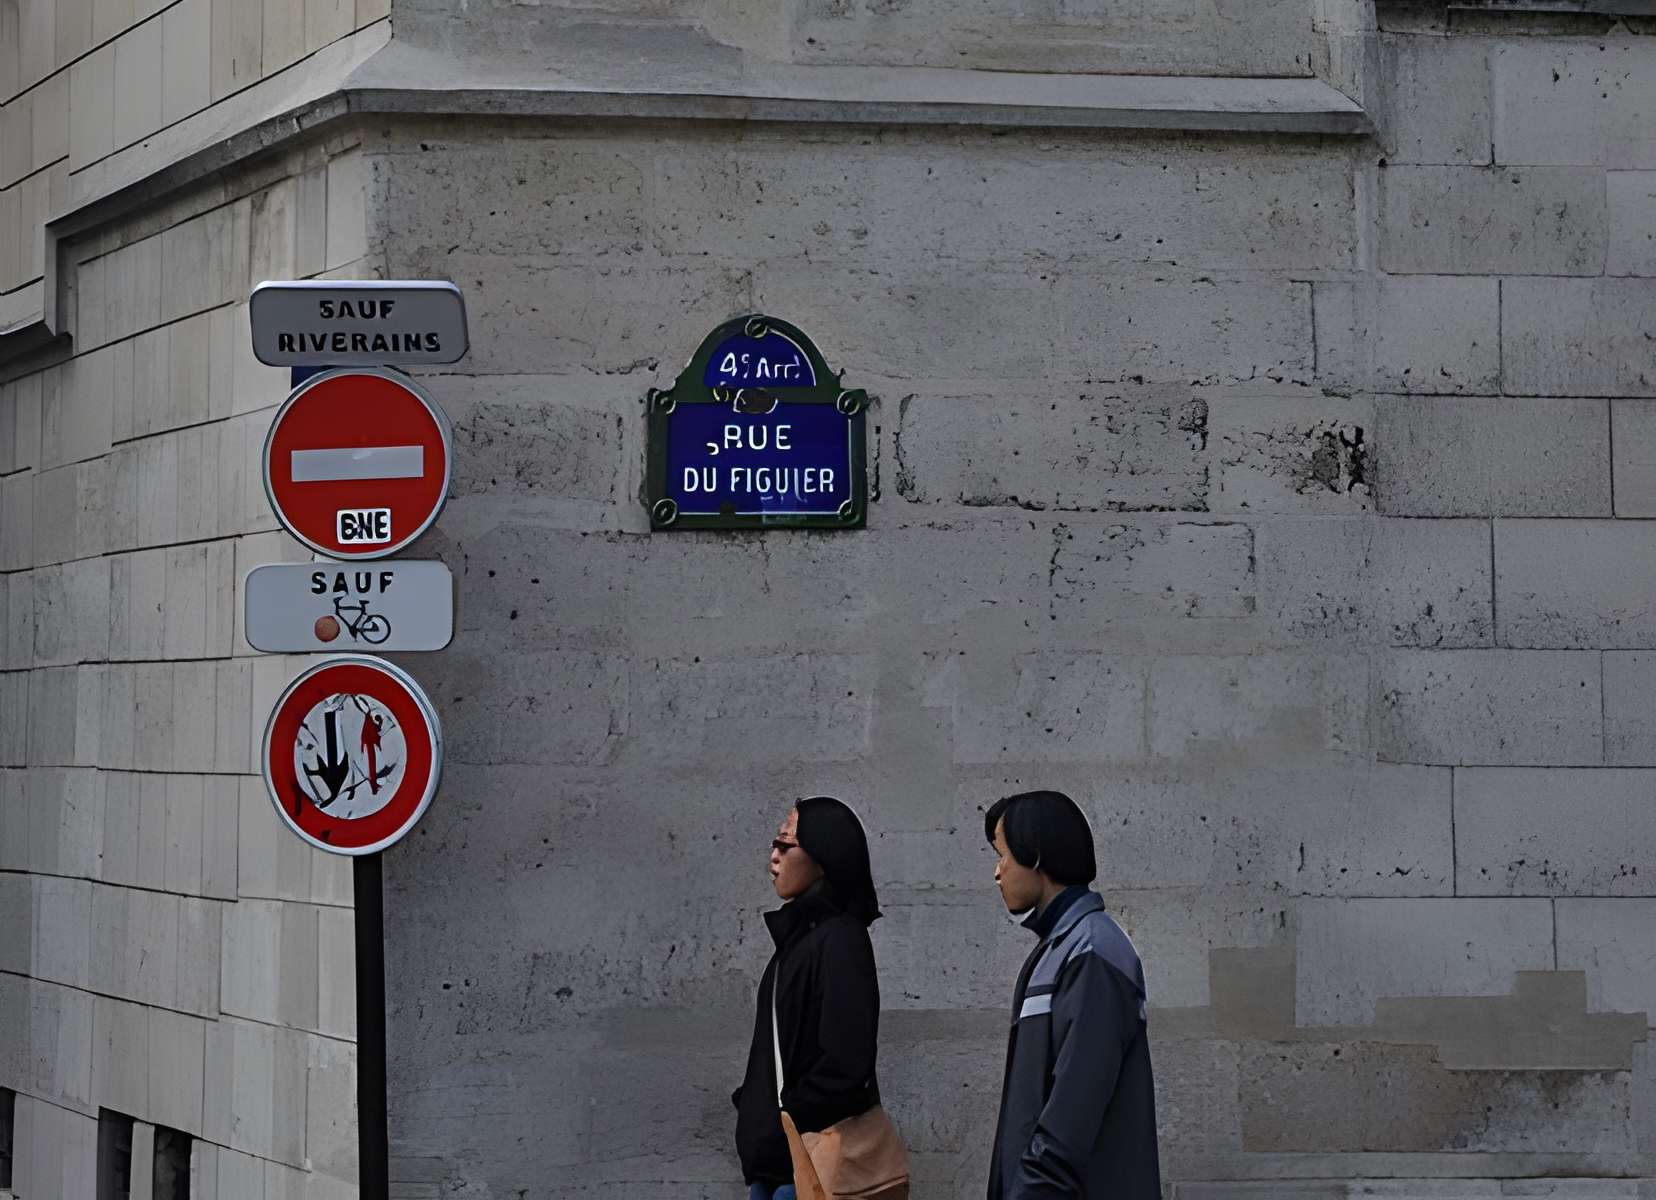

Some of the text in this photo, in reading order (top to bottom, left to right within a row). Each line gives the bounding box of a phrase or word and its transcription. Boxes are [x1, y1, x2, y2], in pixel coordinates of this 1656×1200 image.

[319, 300, 395, 319] SAUF
[278, 332, 441, 353] RIVERAINS
[724, 424, 792, 450] RUE
[683, 467, 834, 494] DU FIGUIER
[311, 571, 394, 594] SAUF
